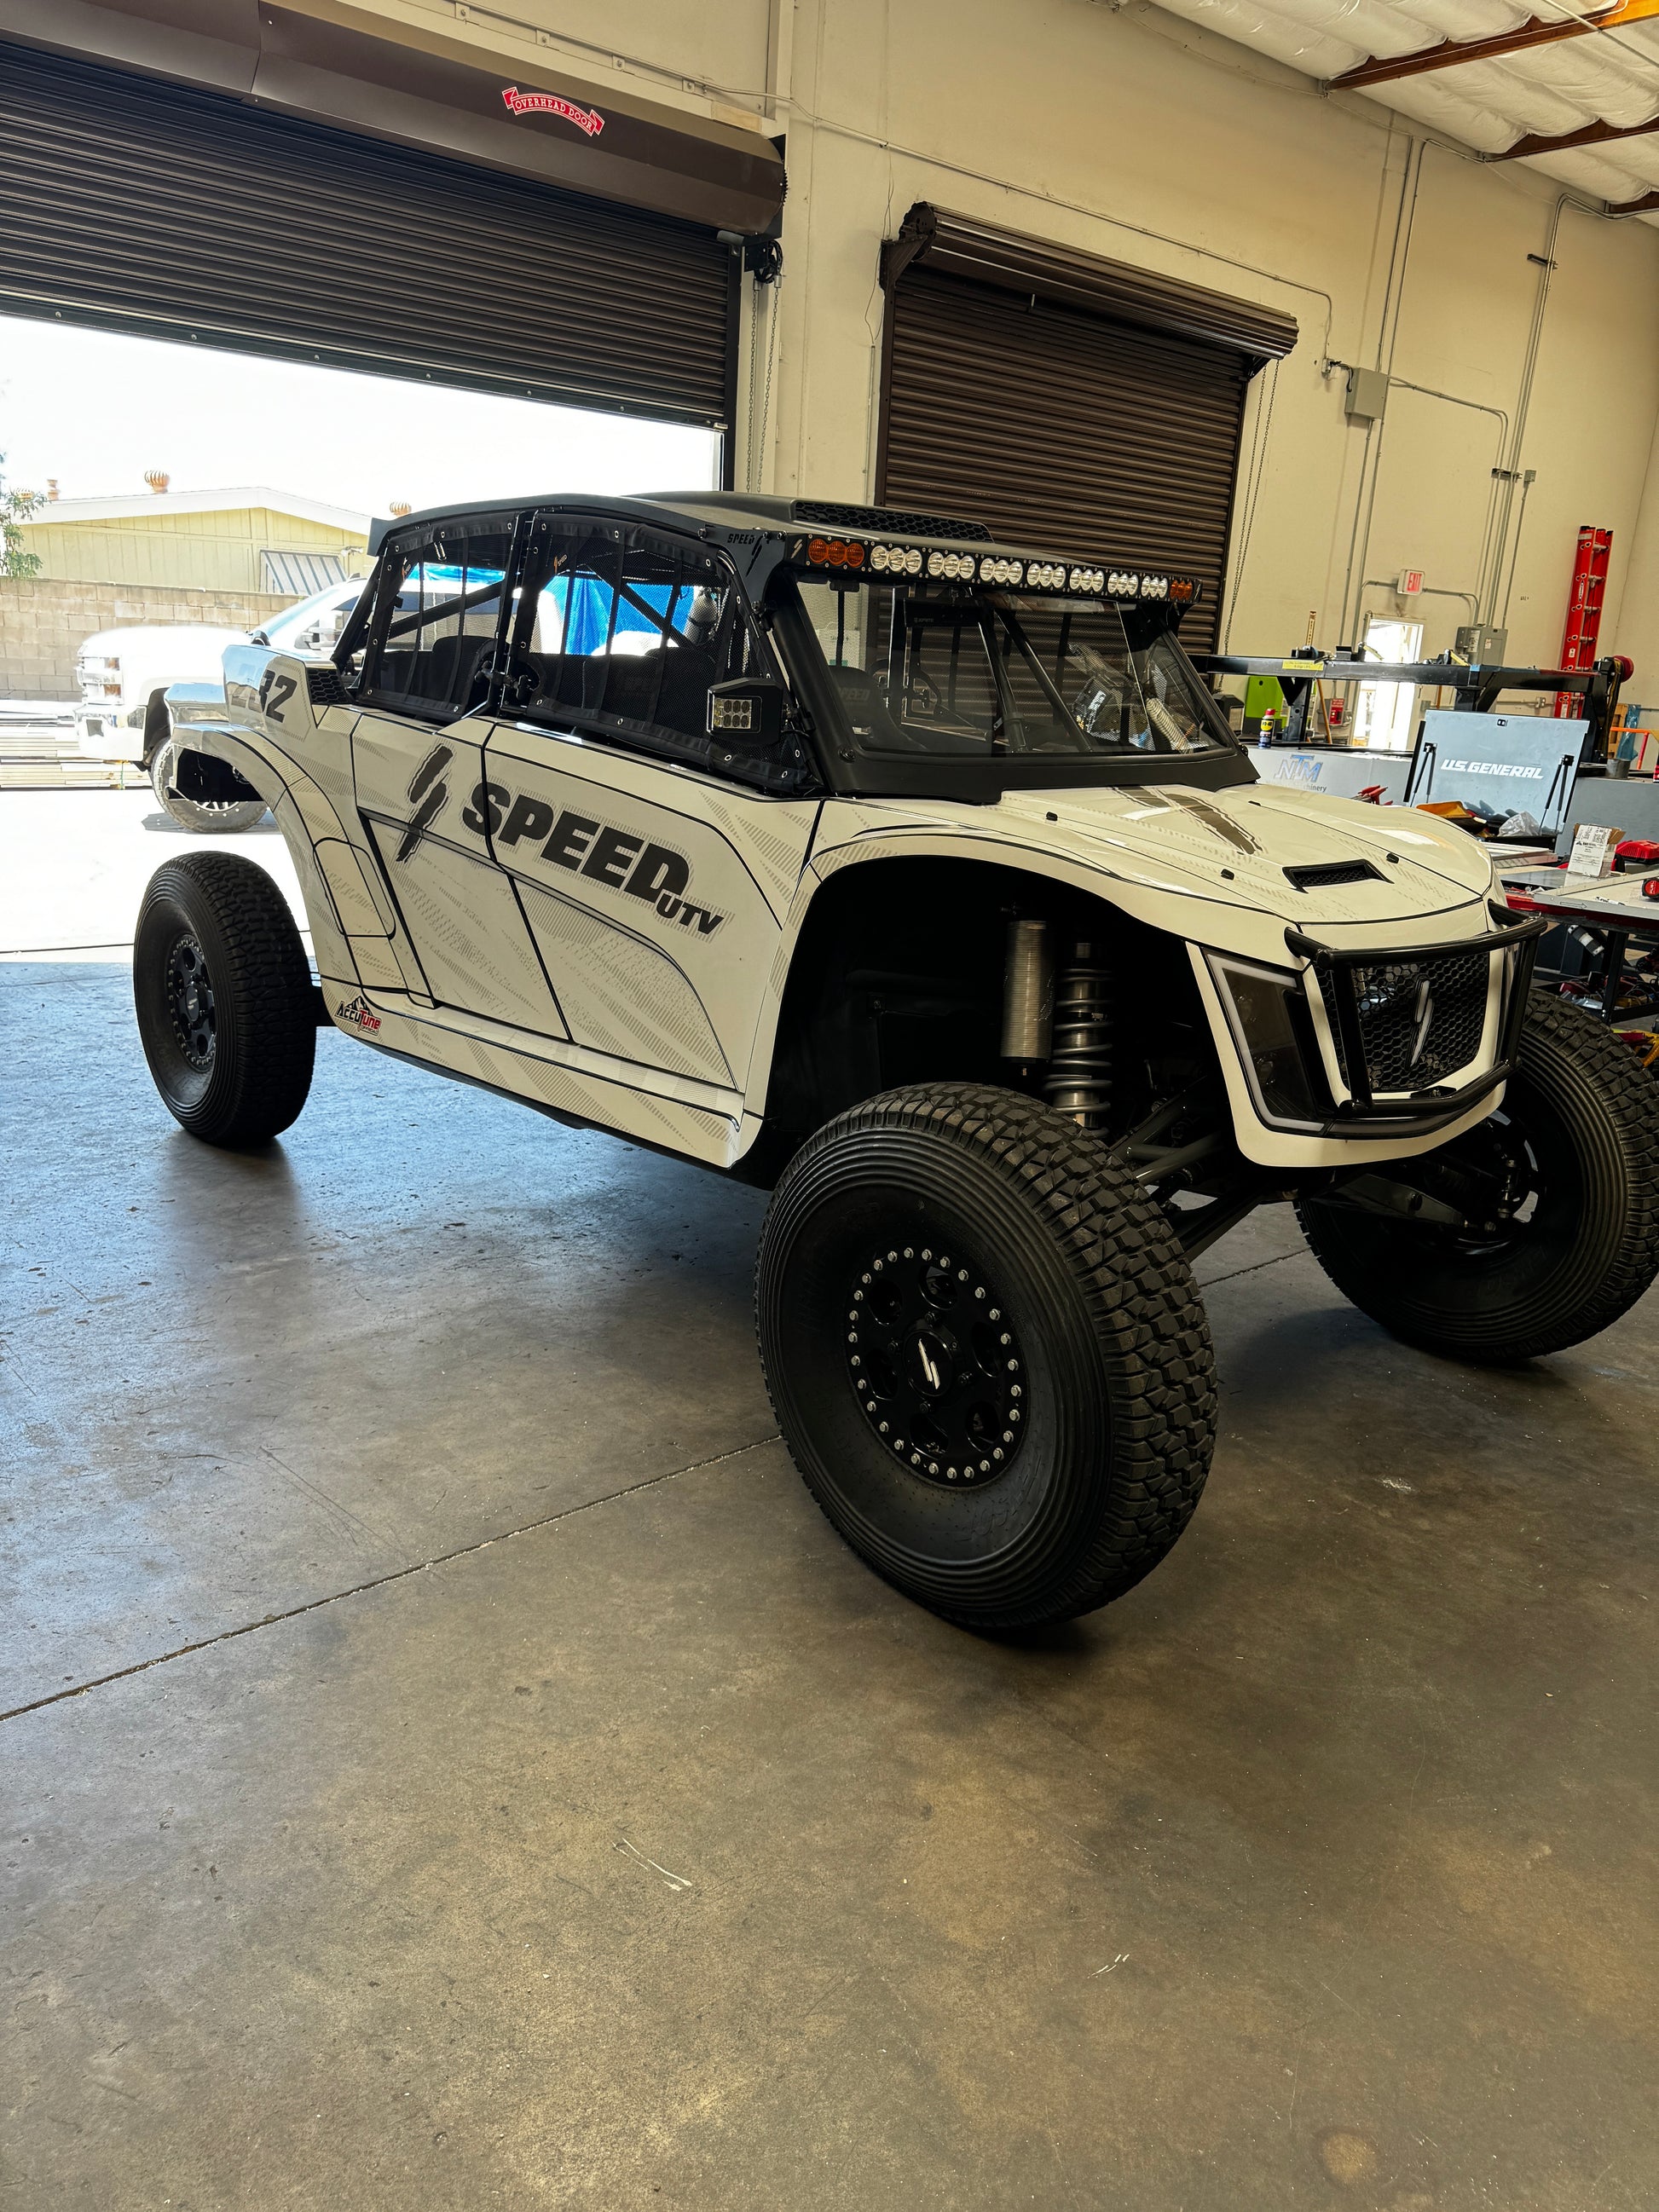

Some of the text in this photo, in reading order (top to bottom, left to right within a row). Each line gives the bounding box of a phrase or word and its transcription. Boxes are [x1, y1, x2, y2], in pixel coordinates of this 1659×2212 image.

[515, 97, 592, 130] OVERHEAD DOOR
[727, 533, 755, 545] SPEED
[1407, 572, 1422, 592] EXIT
[1274, 754, 1323, 783] NTM
[1467, 761, 1544, 779] GENERAL
[462, 781, 690, 904] SPEED
[656, 892, 725, 935] UTV
